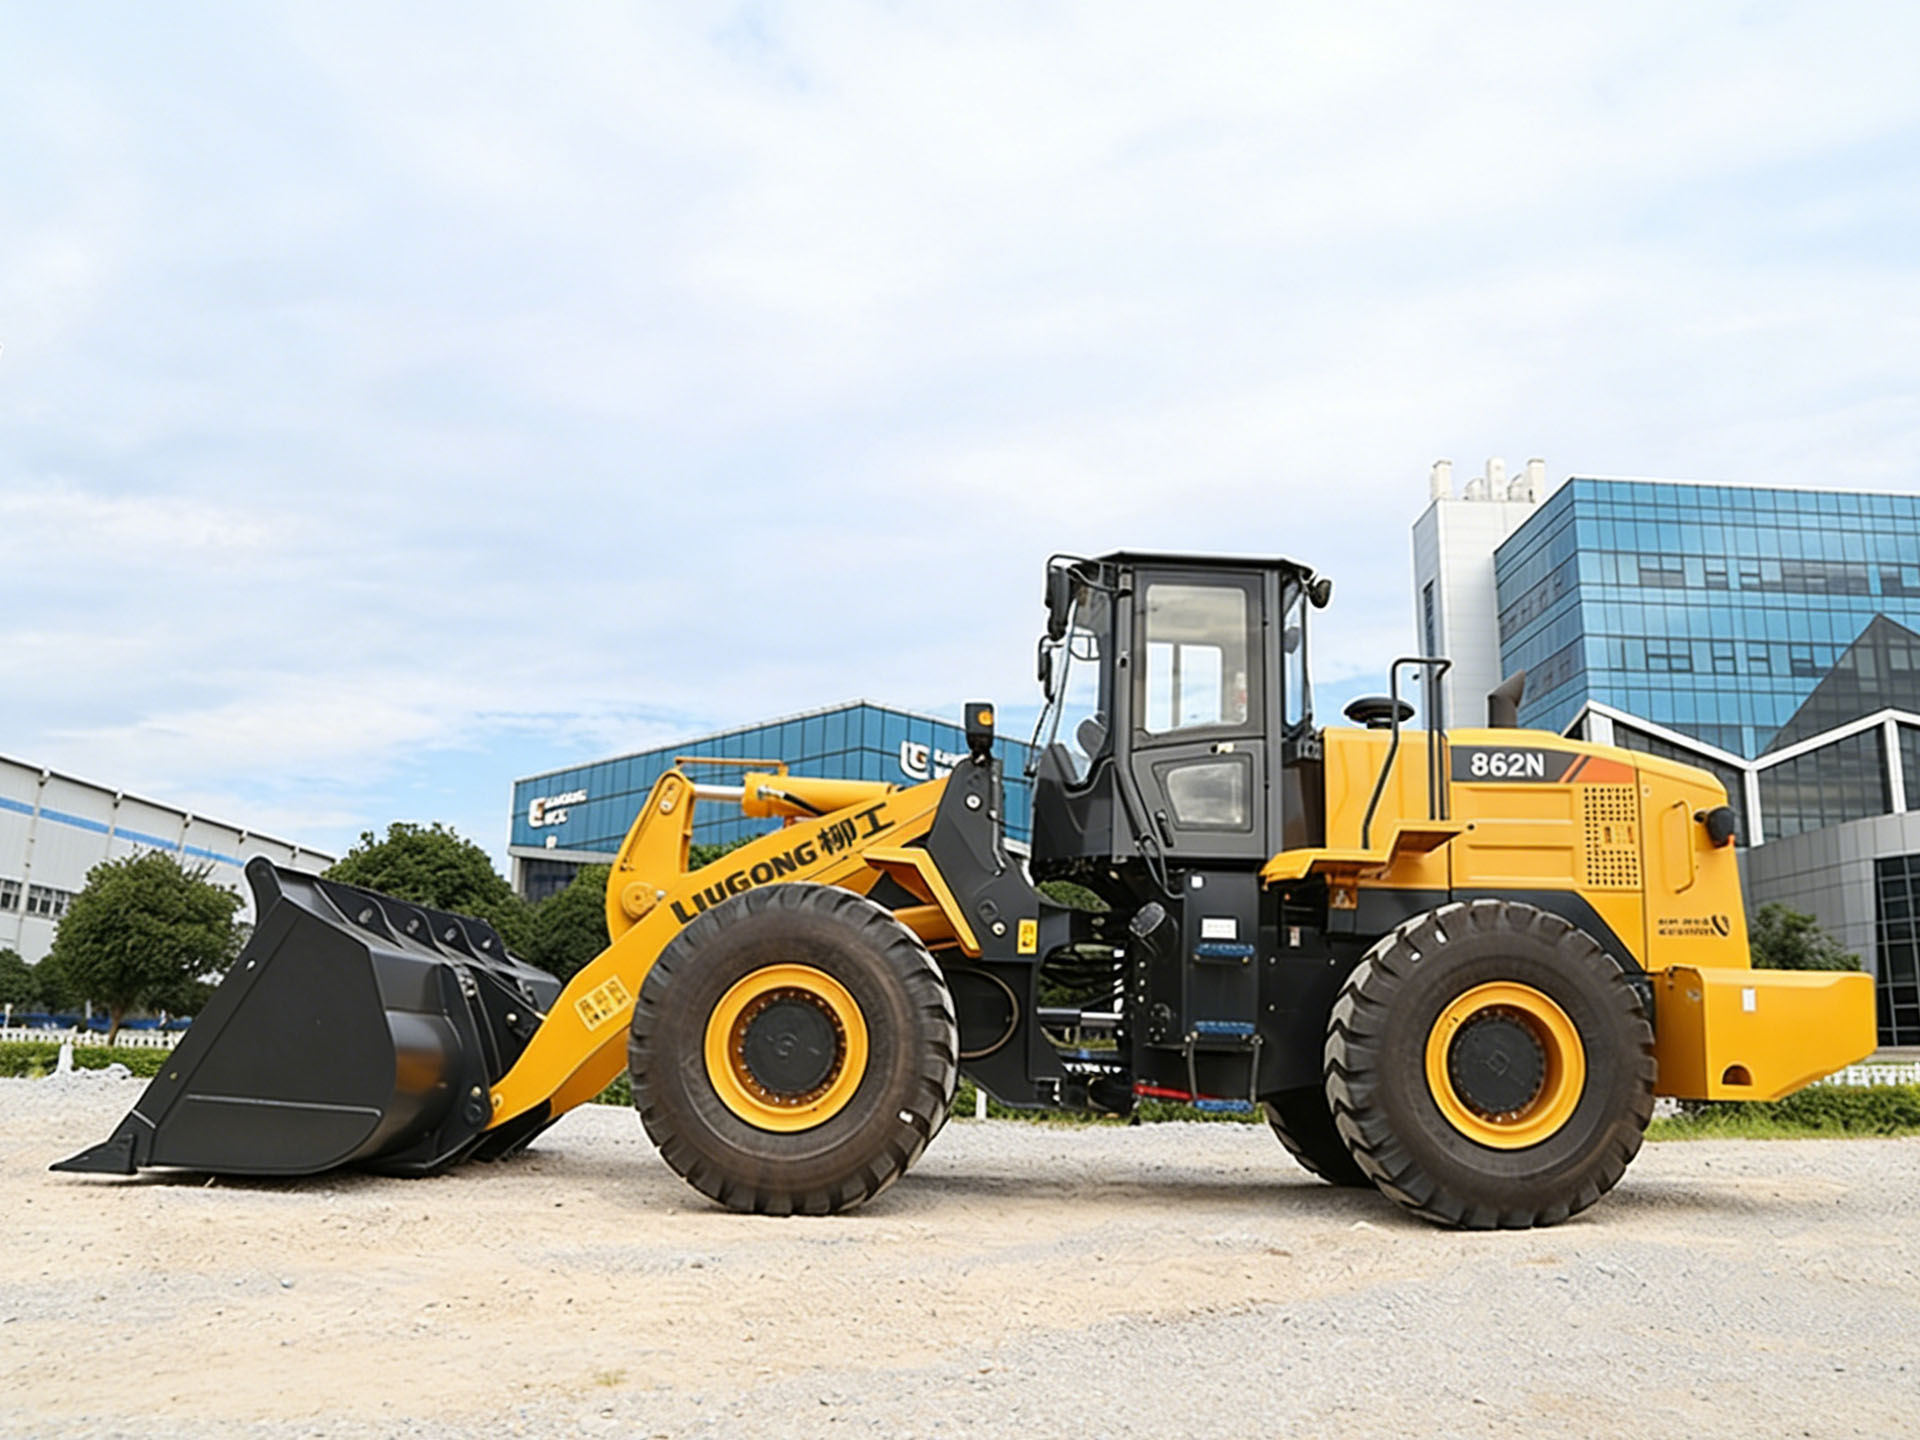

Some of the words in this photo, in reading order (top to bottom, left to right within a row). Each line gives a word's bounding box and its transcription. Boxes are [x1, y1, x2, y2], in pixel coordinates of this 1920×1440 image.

[1471, 752, 1544, 777] 862N
[670, 841, 818, 925] LIUGONG
[817, 802, 896, 856] 柳工
